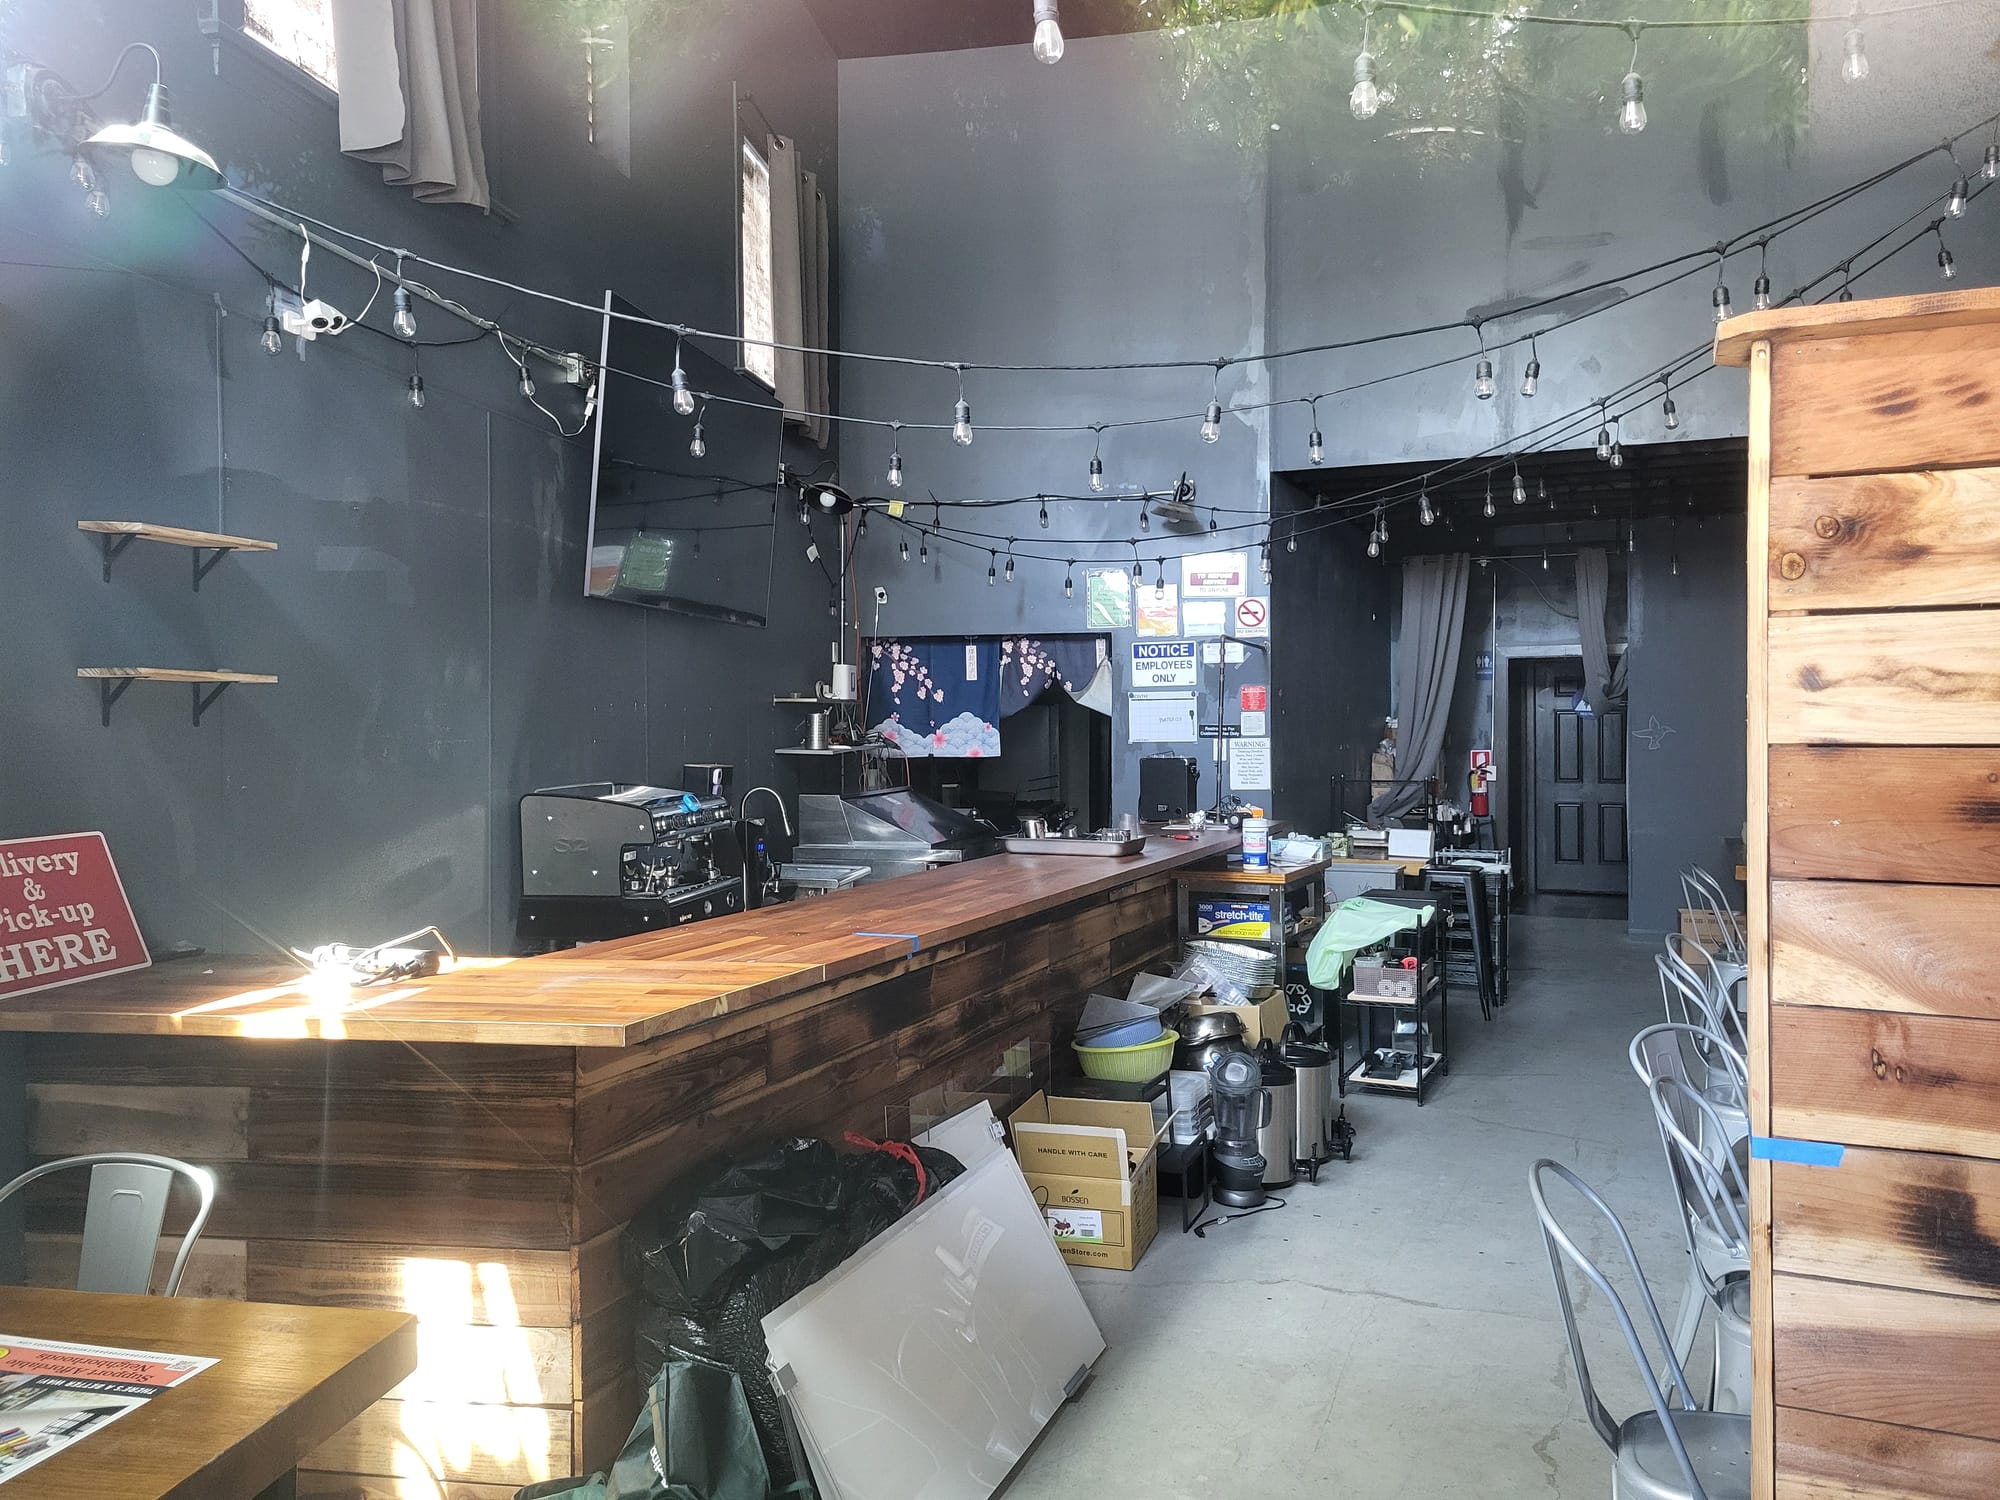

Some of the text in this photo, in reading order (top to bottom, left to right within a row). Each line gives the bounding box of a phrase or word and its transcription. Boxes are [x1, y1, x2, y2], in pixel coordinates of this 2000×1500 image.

[1138, 645, 1189, 656] NOTICE
[1136, 660, 1192, 670] EMPLOYEES
[1152, 674, 1176, 683] ONLY
[23, 877, 46, 901] &
[1214, 910, 1264, 921] stretch-tite
[0, 928, 117, 983] HERE
[1038, 1147, 1108, 1158] HANDLE WITH CARE
[35, 1353, 154, 1372] Neighborhoods
[5, 1359, 154, 1382] Support Affordable
[66, 1381, 104, 1390] BETTER
